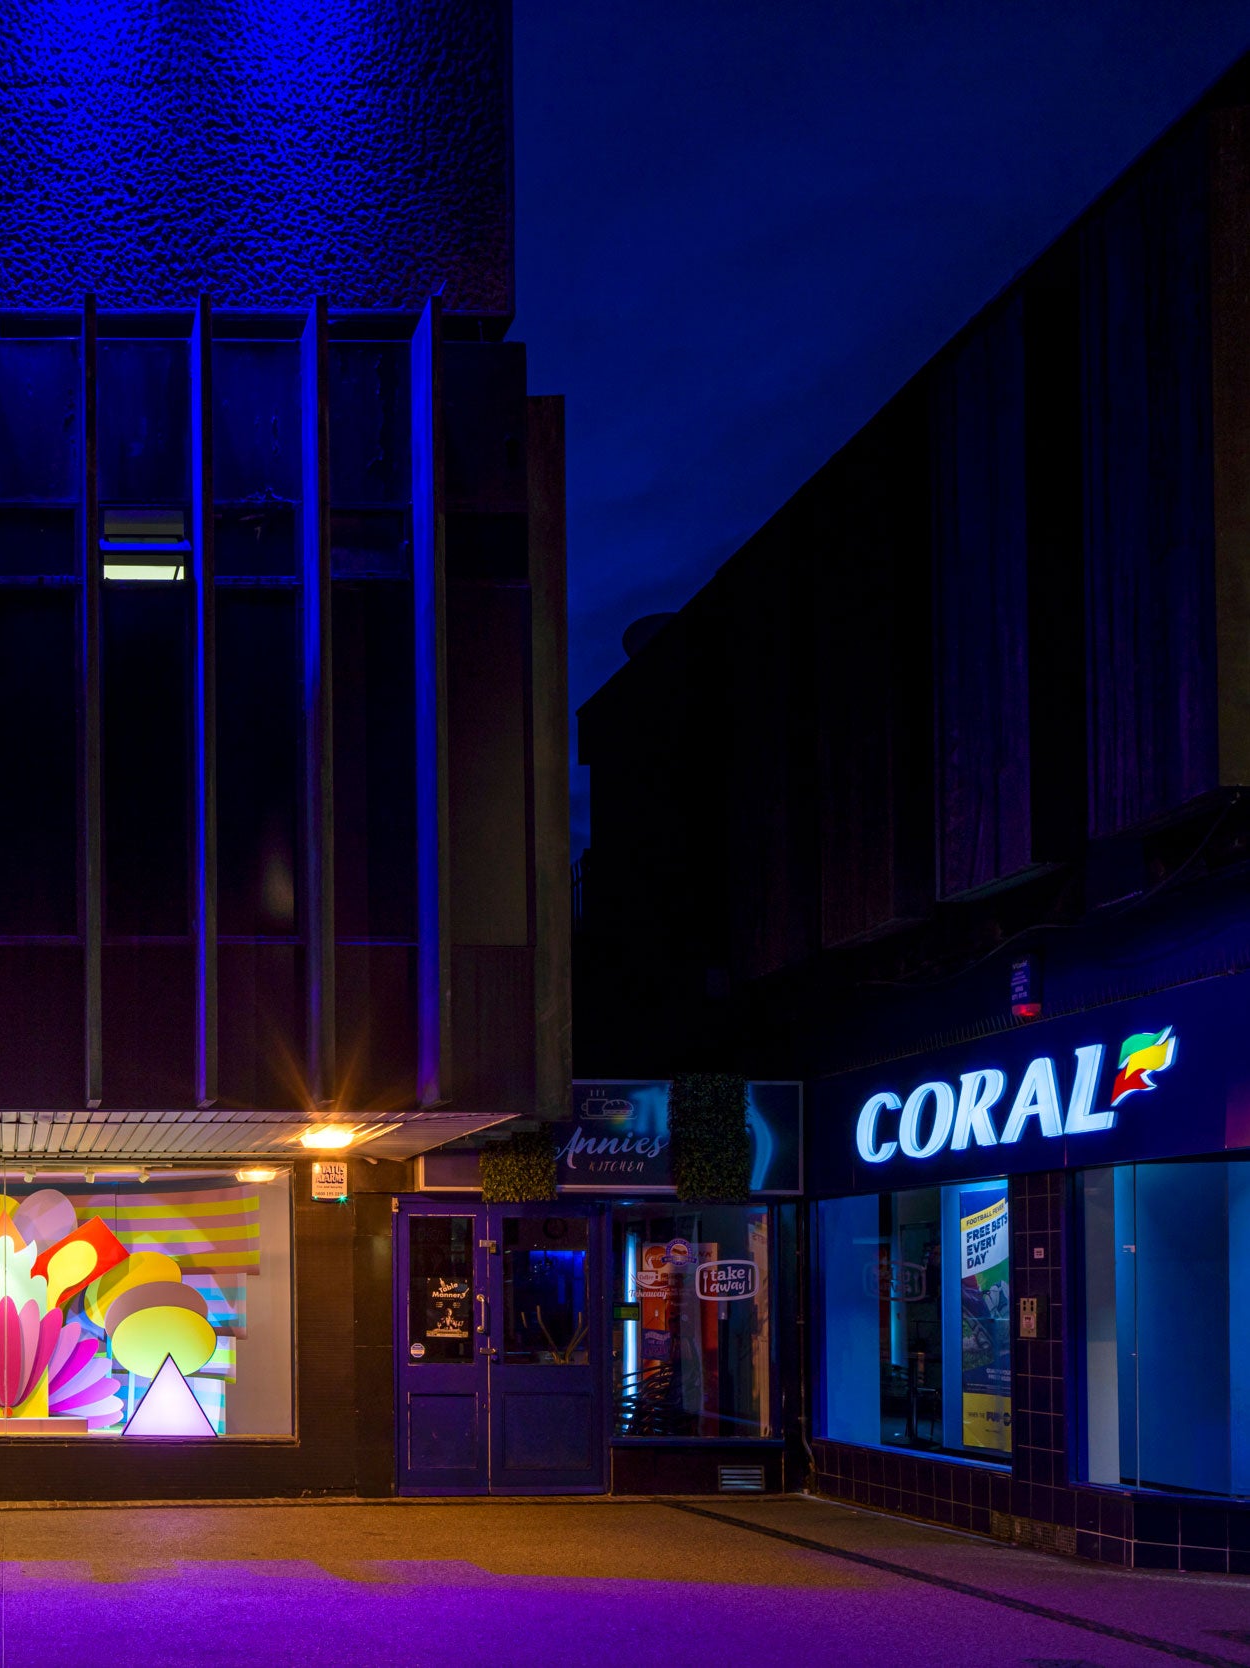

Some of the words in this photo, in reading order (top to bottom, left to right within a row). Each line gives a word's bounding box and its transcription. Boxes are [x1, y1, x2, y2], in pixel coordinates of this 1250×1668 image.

[856, 1043, 1118, 1164] CORAL
[553, 1125, 671, 1169] Annies
[316, 1165, 344, 1175] TATUS
[589, 1161, 645, 1172] KITCHEN
[316, 1175, 344, 1184] ALARMS
[966, 1212, 992, 1226] FOOTBALL
[992, 1203, 1004, 1215] FEVER
[966, 1223, 990, 1243] FREE
[991, 1212, 1008, 1233] BETS
[966, 1233, 997, 1257] EVERY
[710, 1265, 746, 1281] take
[432, 1290, 467, 1299] Manners
[438, 1281, 458, 1293] Table
[628, 1289, 669, 1300] Takeaway
[709, 1280, 746, 1295] away
